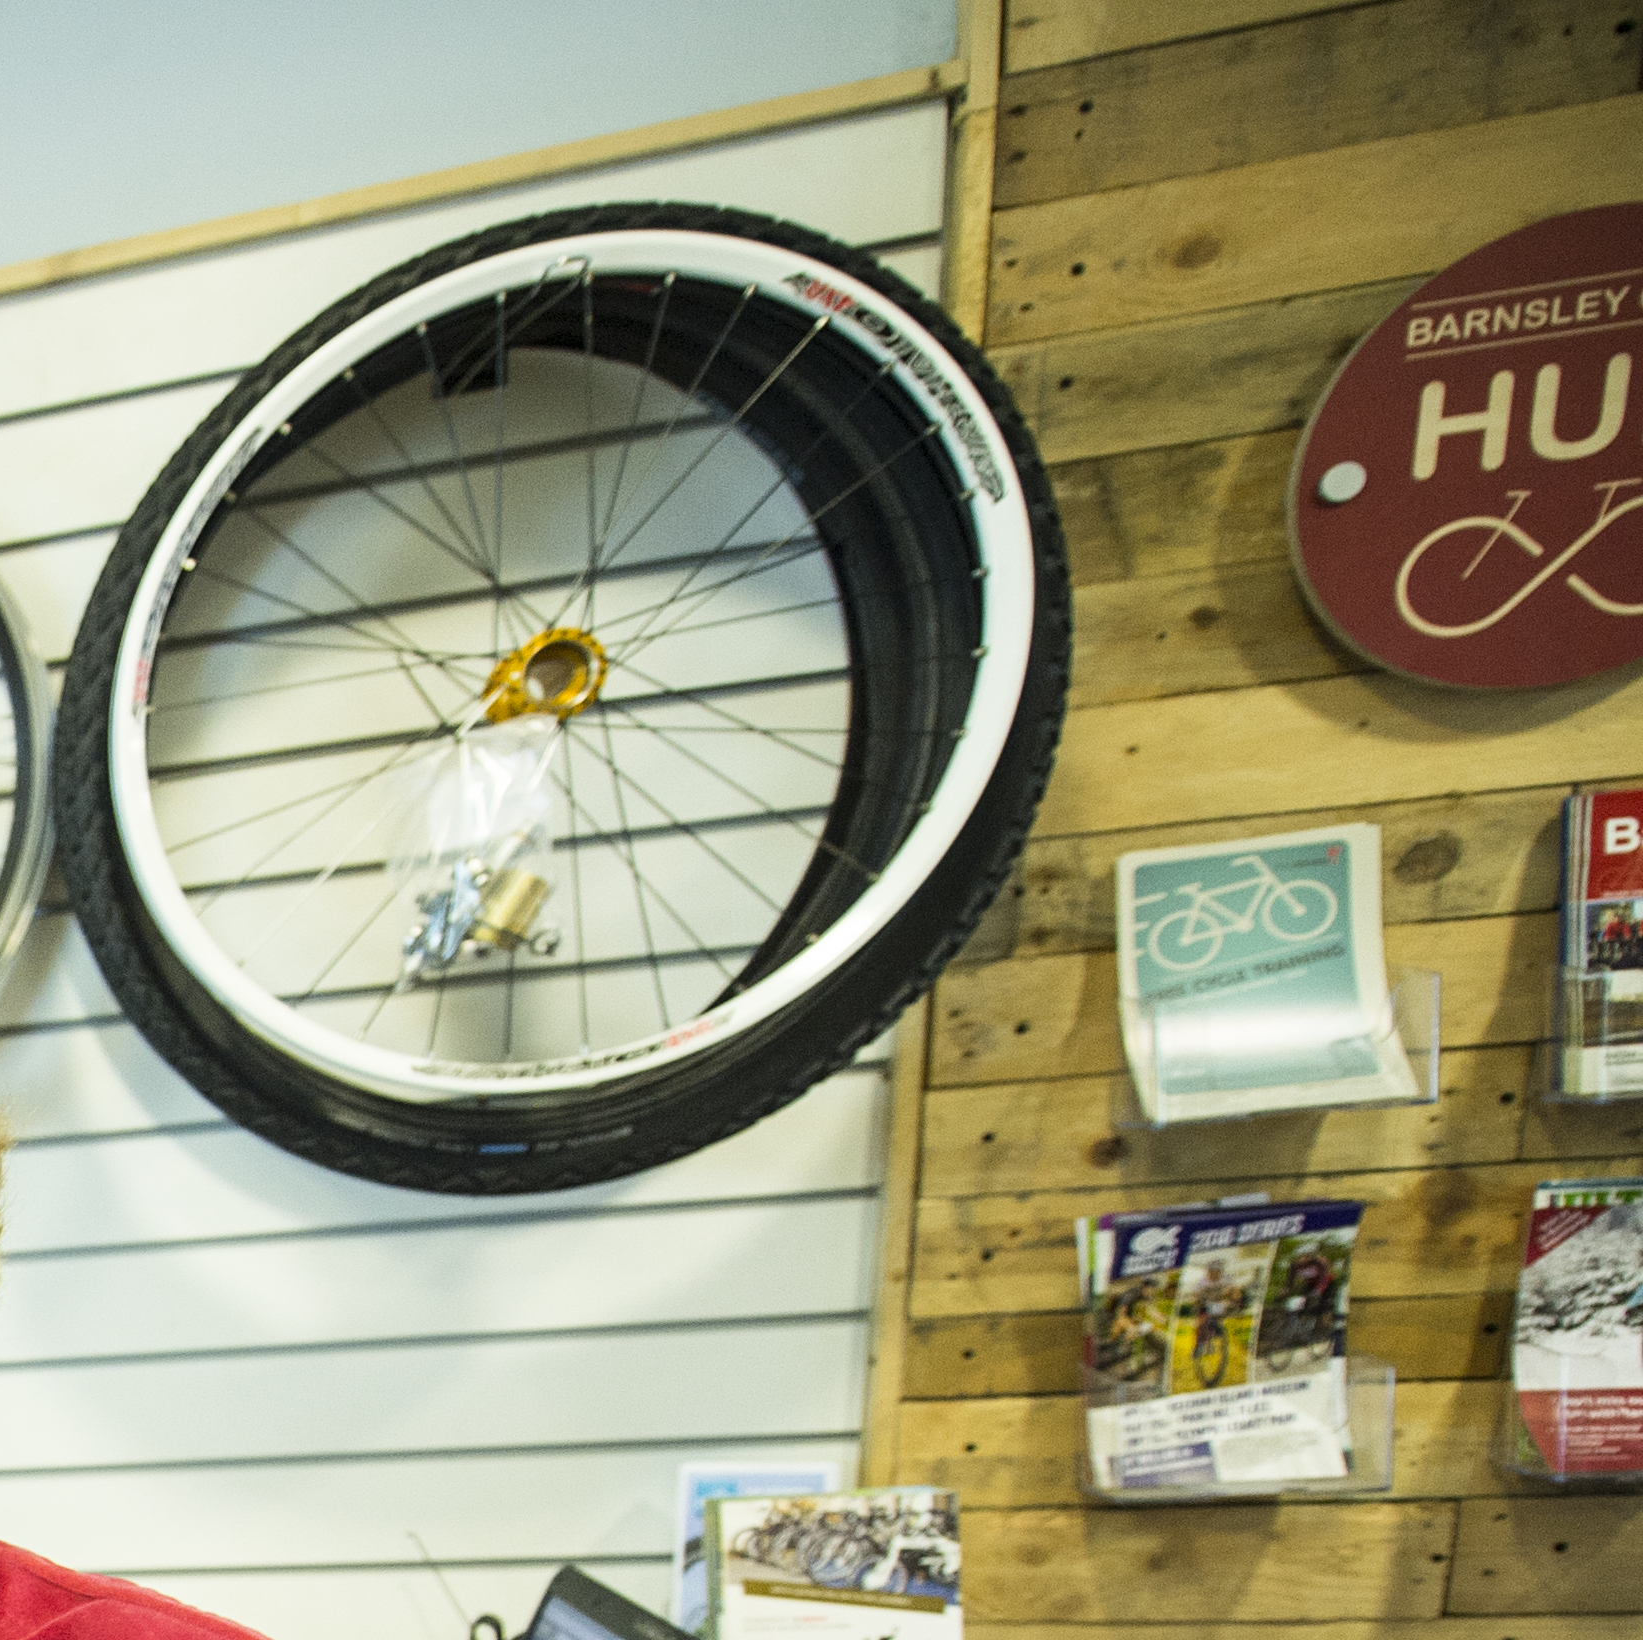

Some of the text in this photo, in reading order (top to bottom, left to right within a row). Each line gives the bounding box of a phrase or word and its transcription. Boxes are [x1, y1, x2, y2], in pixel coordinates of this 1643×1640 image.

[1406, 284, 1630, 349] BARNSLEY
[1411, 352, 1643, 483] HU
[1252, 944, 1345, 978] TRAINING
